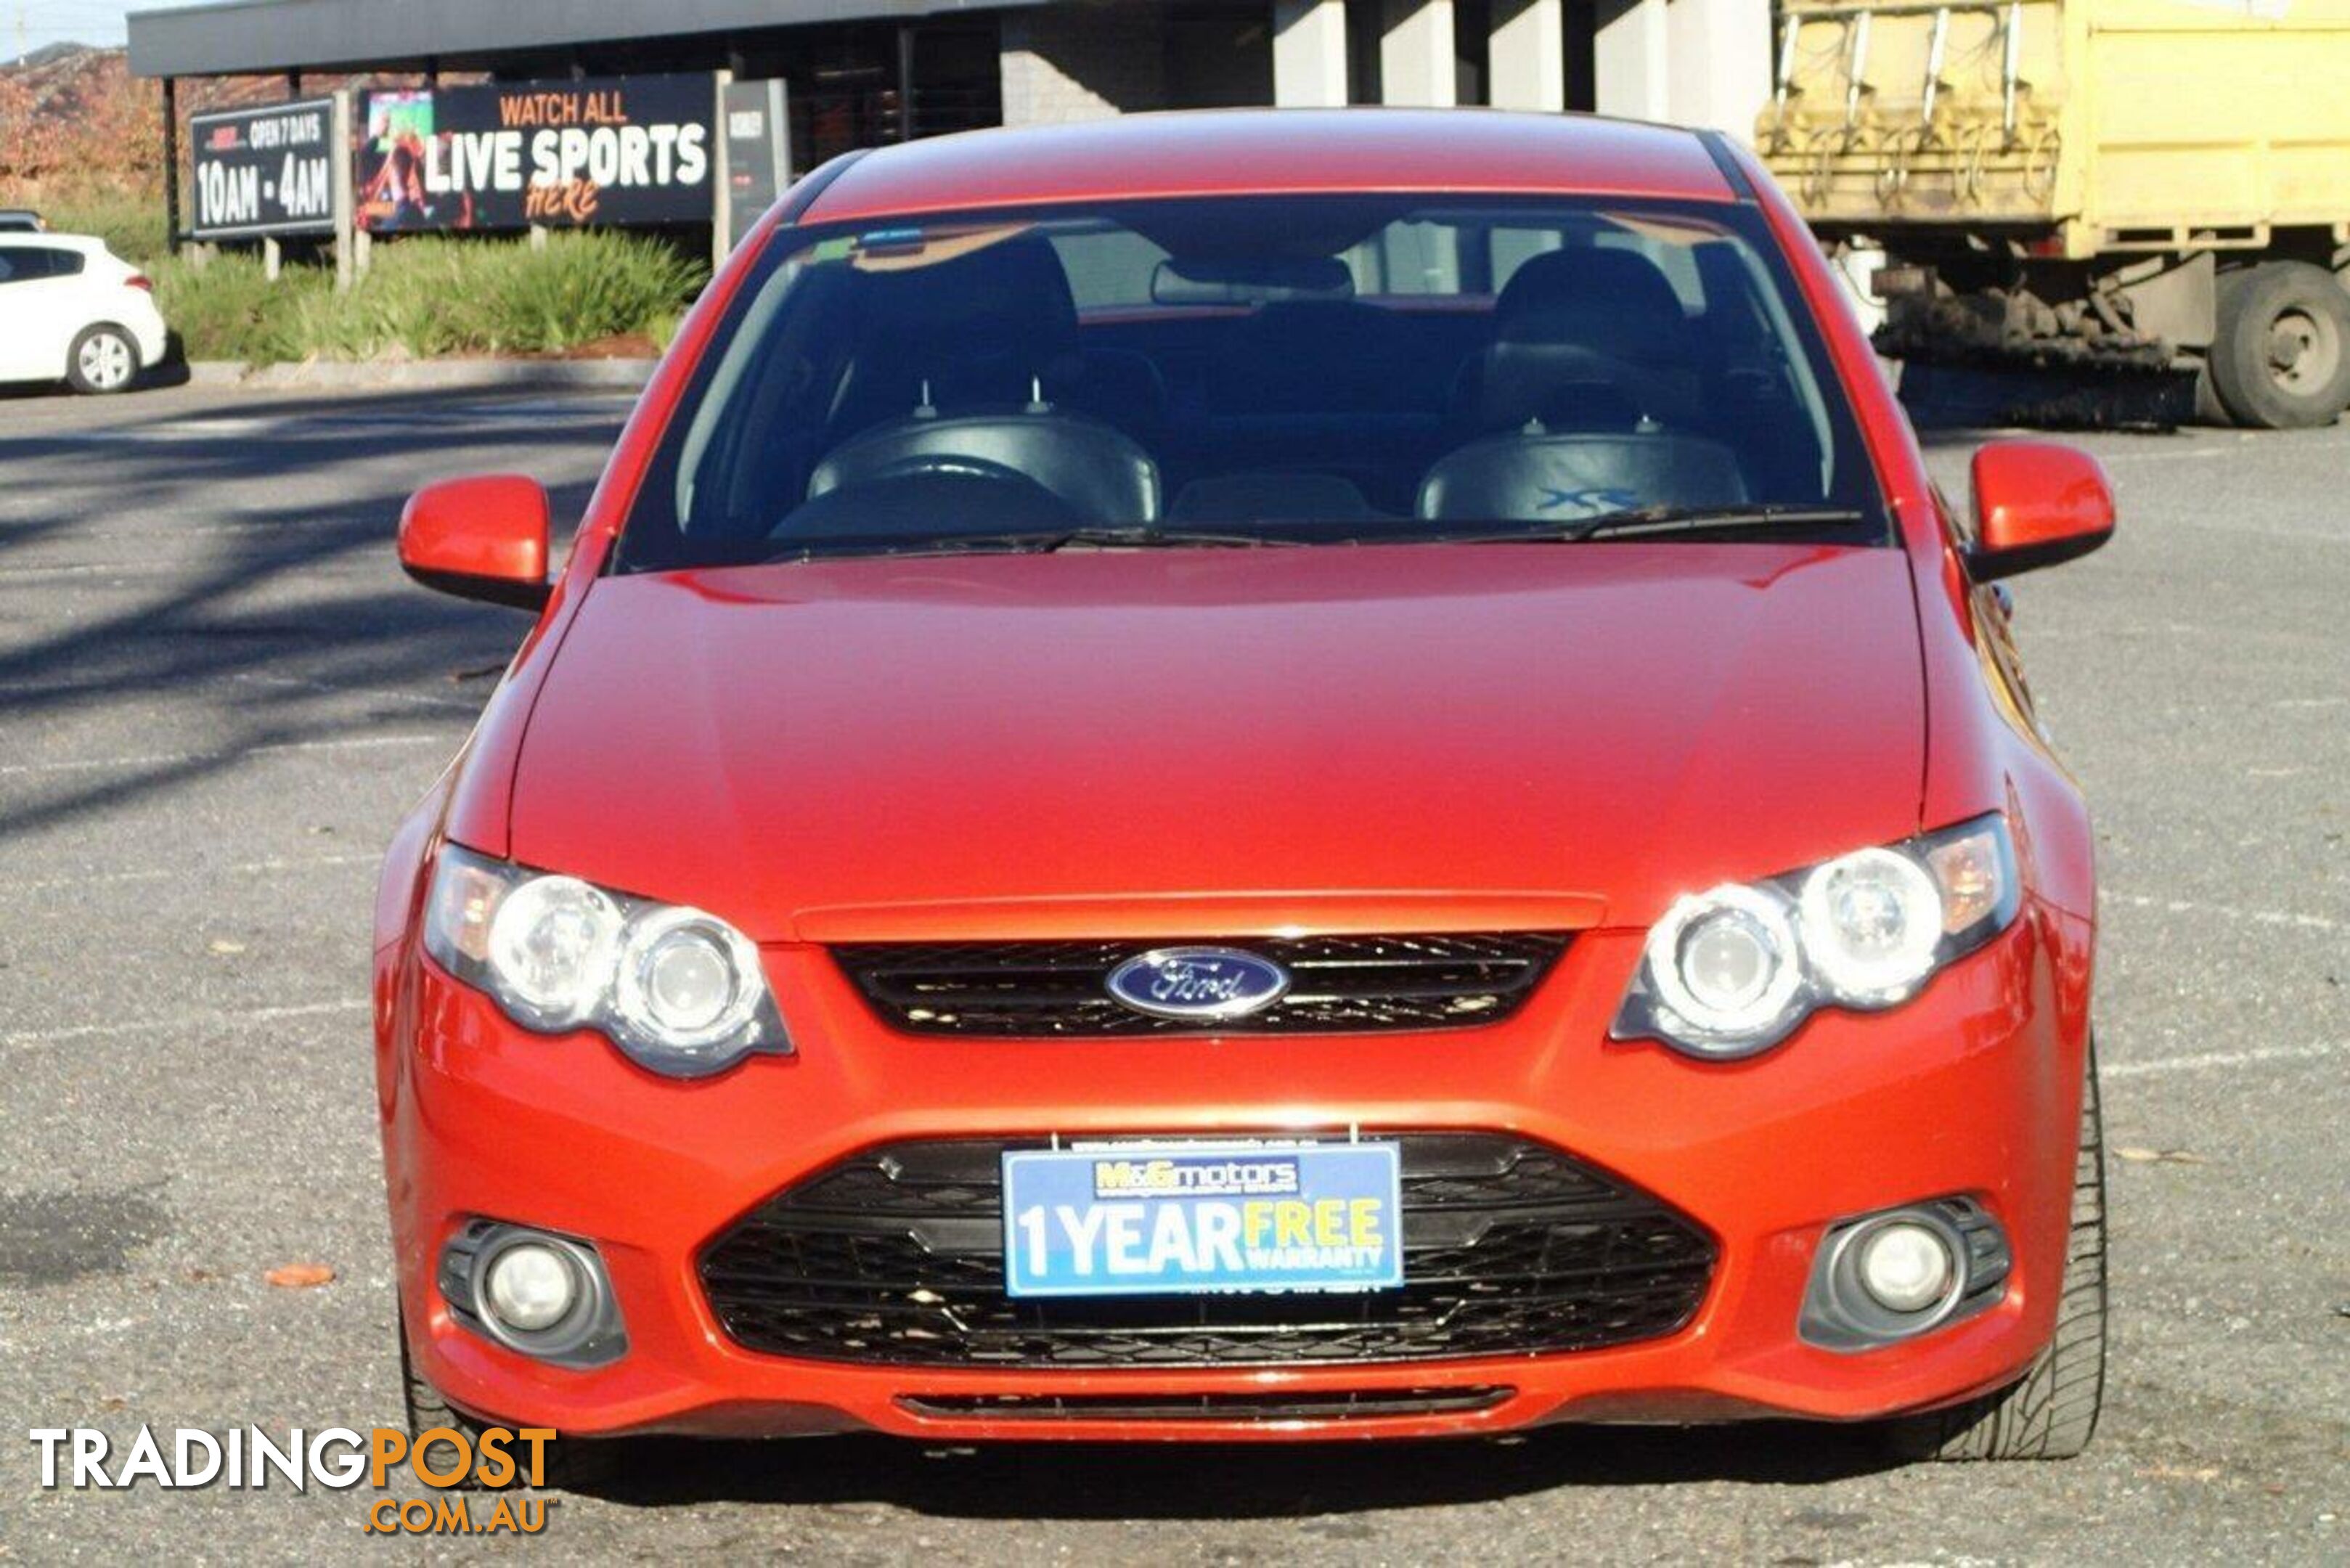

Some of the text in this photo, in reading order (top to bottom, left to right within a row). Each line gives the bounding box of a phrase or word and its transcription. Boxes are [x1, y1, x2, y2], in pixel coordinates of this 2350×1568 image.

[499, 90, 628, 126] WATCH ALL
[250, 119, 280, 150] OPEN
[281, 117, 289, 144] 7
[290, 113, 321, 144] DAYS
[425, 131, 523, 192] LIVE
[531, 123, 707, 188] SPORTS
[197, 160, 258, 225] 10AM
[279, 152, 328, 216] 4AM
[526, 178, 600, 222] HERE
[1151, 959, 1246, 1000] Ford
[1018, 1199, 1383, 1276] 1 YEAR FREE
[1245, 1246, 1383, 1270] WARRANTY
